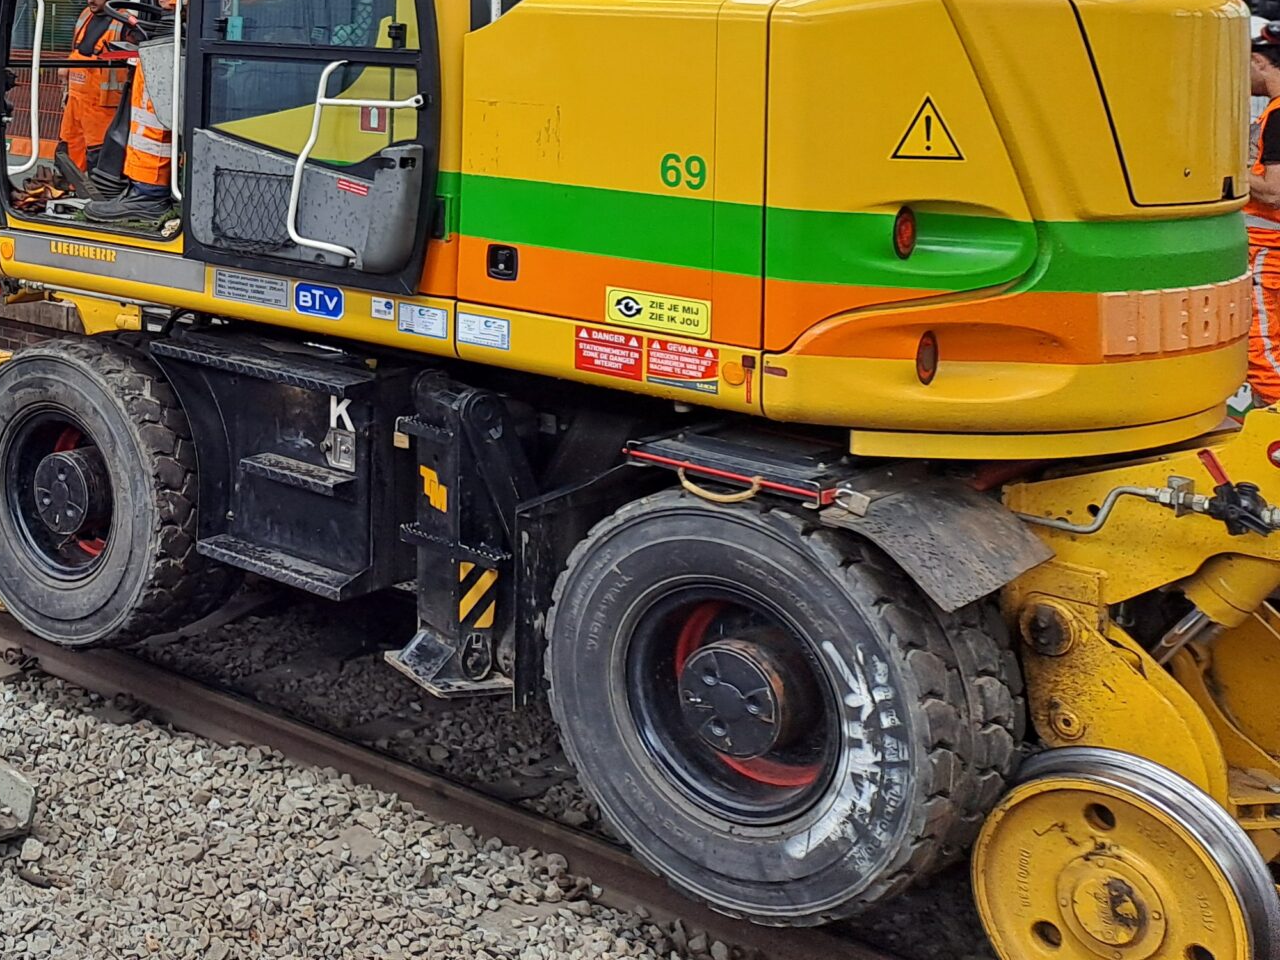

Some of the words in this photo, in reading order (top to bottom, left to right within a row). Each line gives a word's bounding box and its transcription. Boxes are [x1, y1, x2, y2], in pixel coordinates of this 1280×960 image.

[661, 153, 706, 191] 69
[50, 240, 117, 263] LIEBHERR
[299, 289, 339, 311] BTV
[649, 300, 665, 310] ZIE
[667, 303, 678, 312] JE
[682, 305, 699, 316] MIJ
[648, 312, 665, 322] ZIE
[667, 315, 677, 324] IK
[680, 317, 700, 328] JOU
[592, 330, 625, 344] DANGER
[666, 343, 699, 355] GEVAAR
[582, 350, 599, 358] ZONE
[609, 354, 635, 365] DANGER
[330, 395, 356, 433] K
